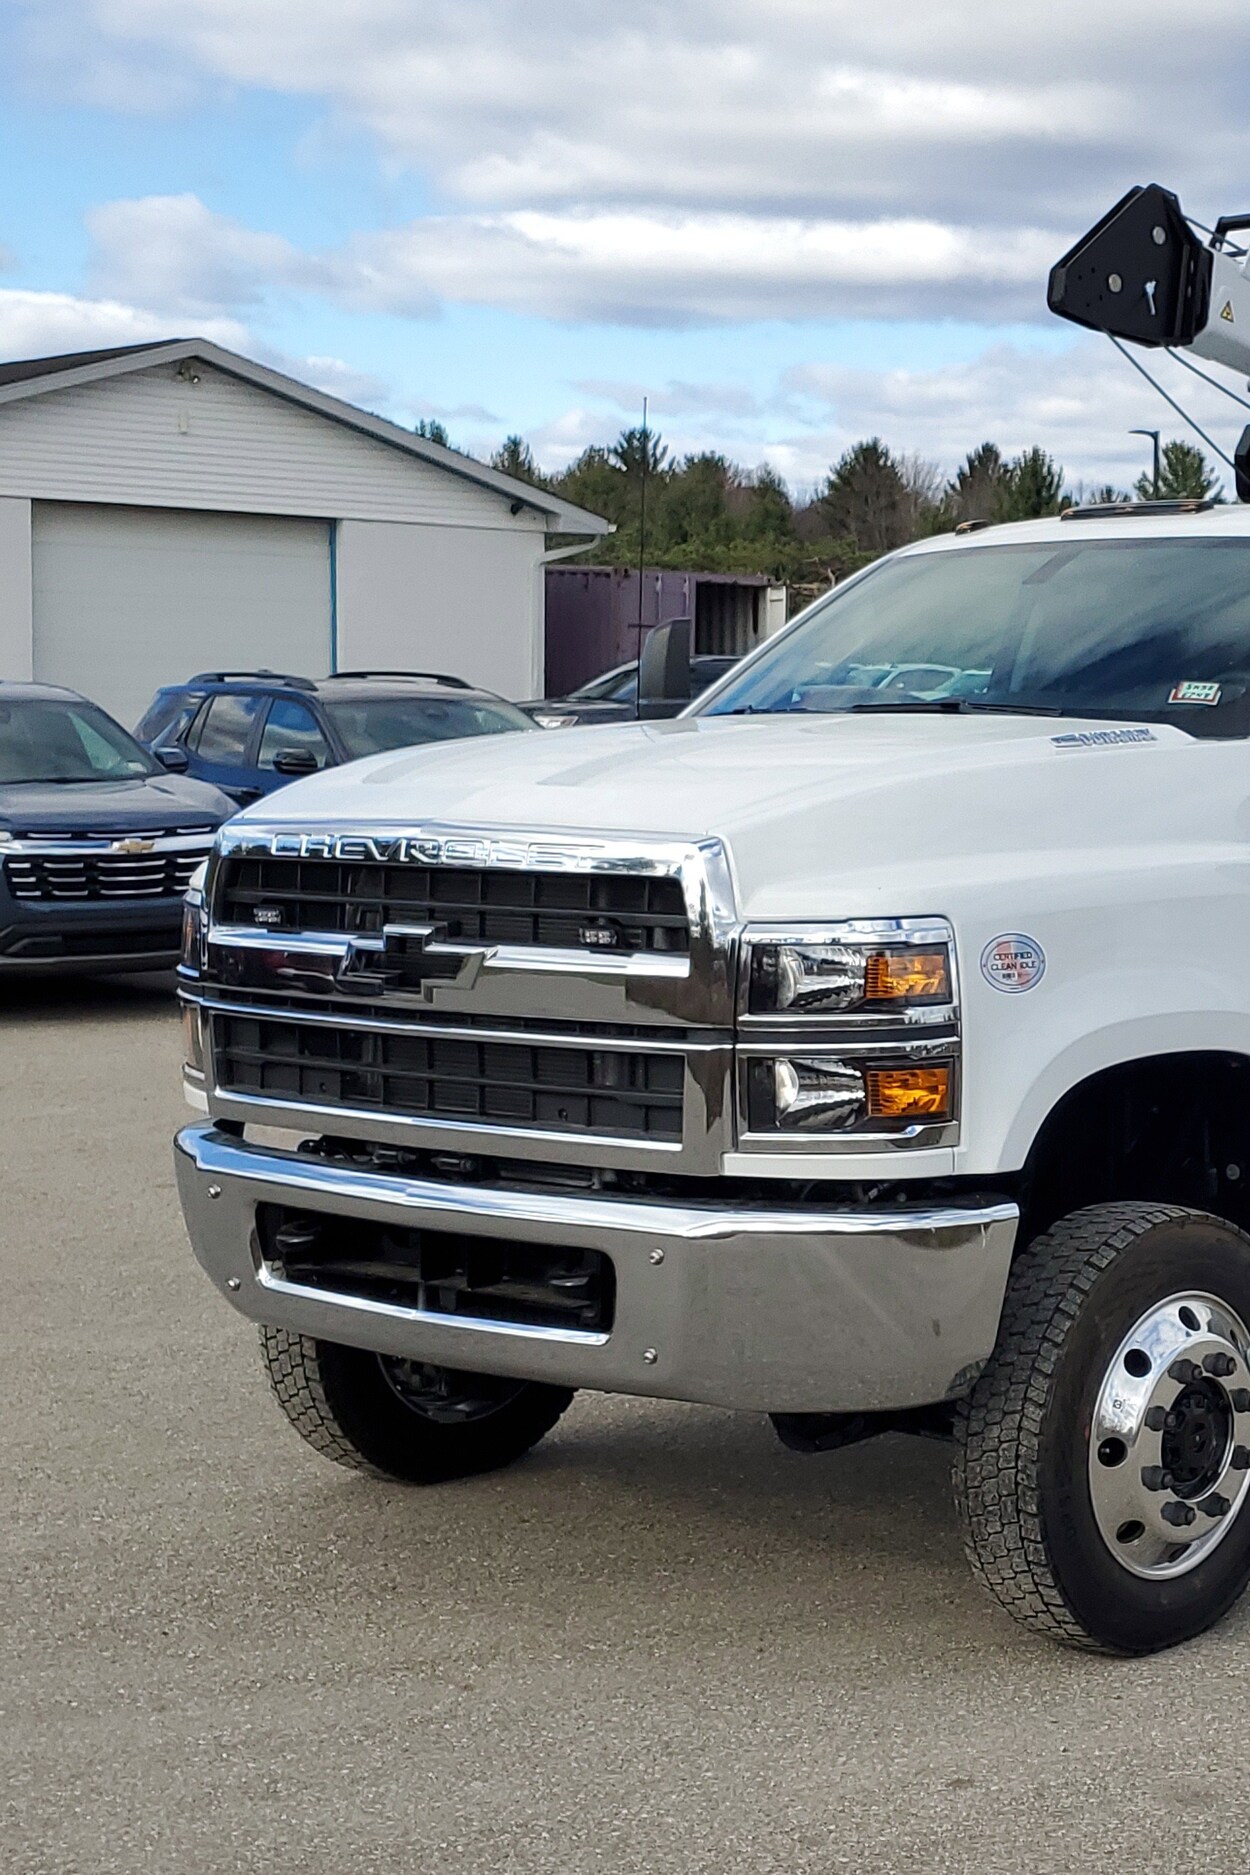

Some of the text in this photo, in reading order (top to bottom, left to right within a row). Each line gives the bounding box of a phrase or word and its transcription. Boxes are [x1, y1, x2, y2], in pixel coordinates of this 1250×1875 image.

[271, 832, 605, 869] CHEVROLET
[993, 952, 1032, 961] CERTIFIED
[991, 960, 1037, 971] CLEAN IDLE
